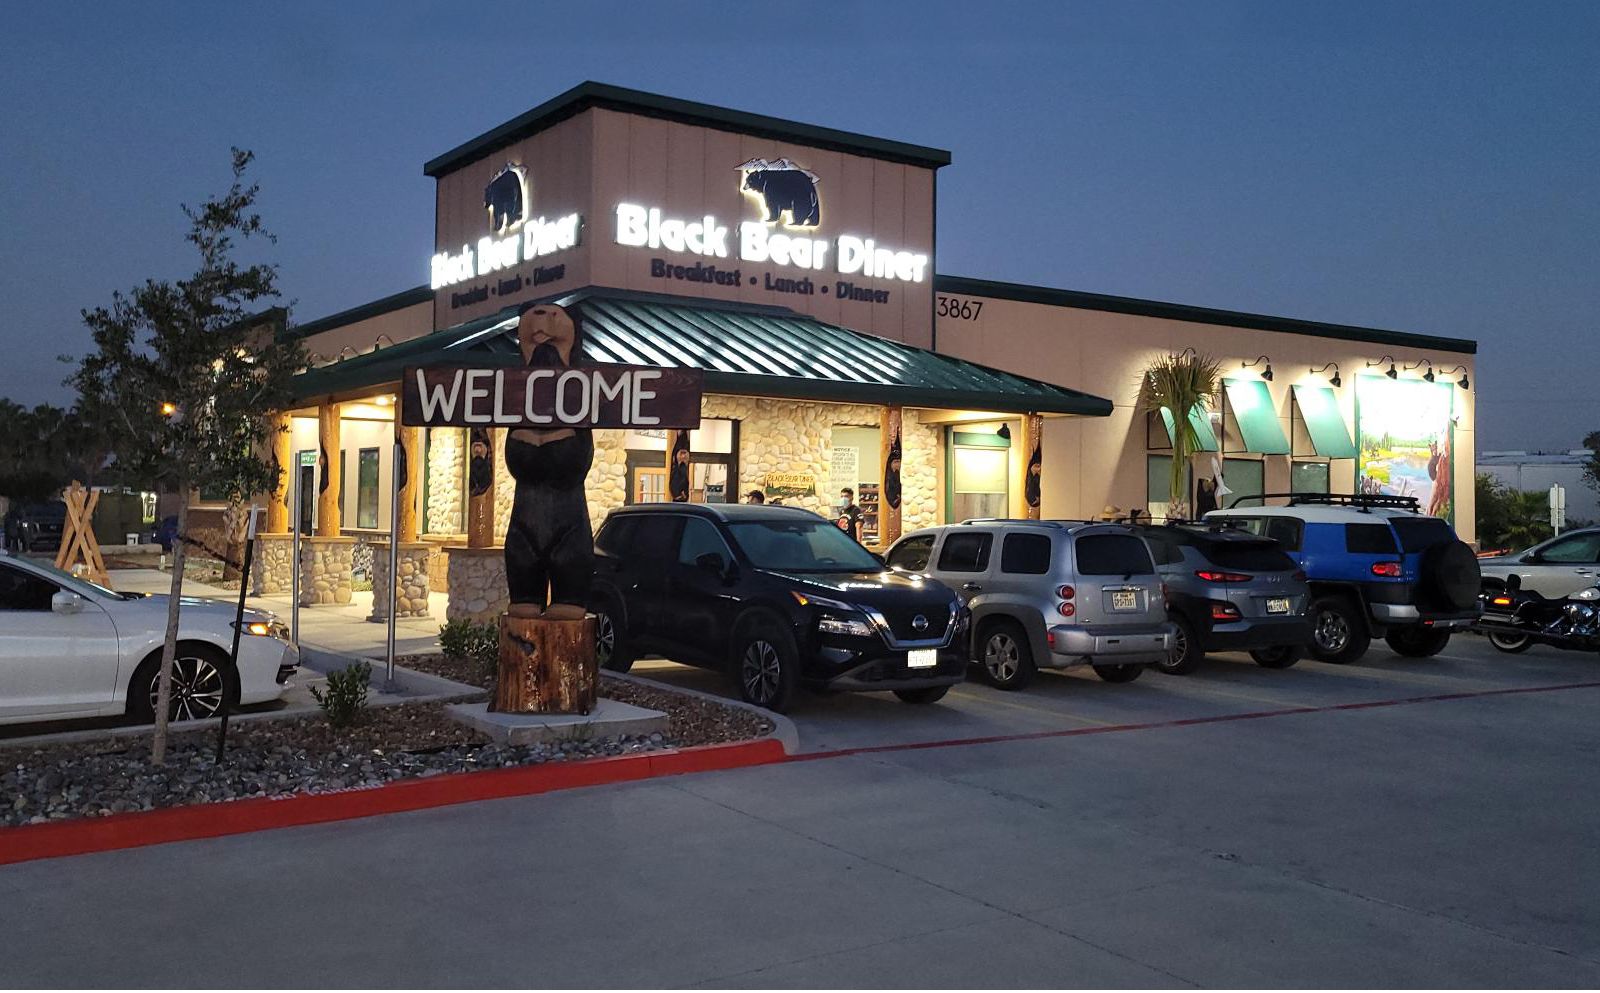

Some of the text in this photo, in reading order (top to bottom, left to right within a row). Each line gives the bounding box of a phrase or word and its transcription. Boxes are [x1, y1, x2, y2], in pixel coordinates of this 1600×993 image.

[616, 203, 929, 283] Black Bear Diner
[651, 258, 890, 304] Breakfast Lunch Dinner
[937, 297, 983, 321] 3867
[416, 368, 662, 425] WELCOME
